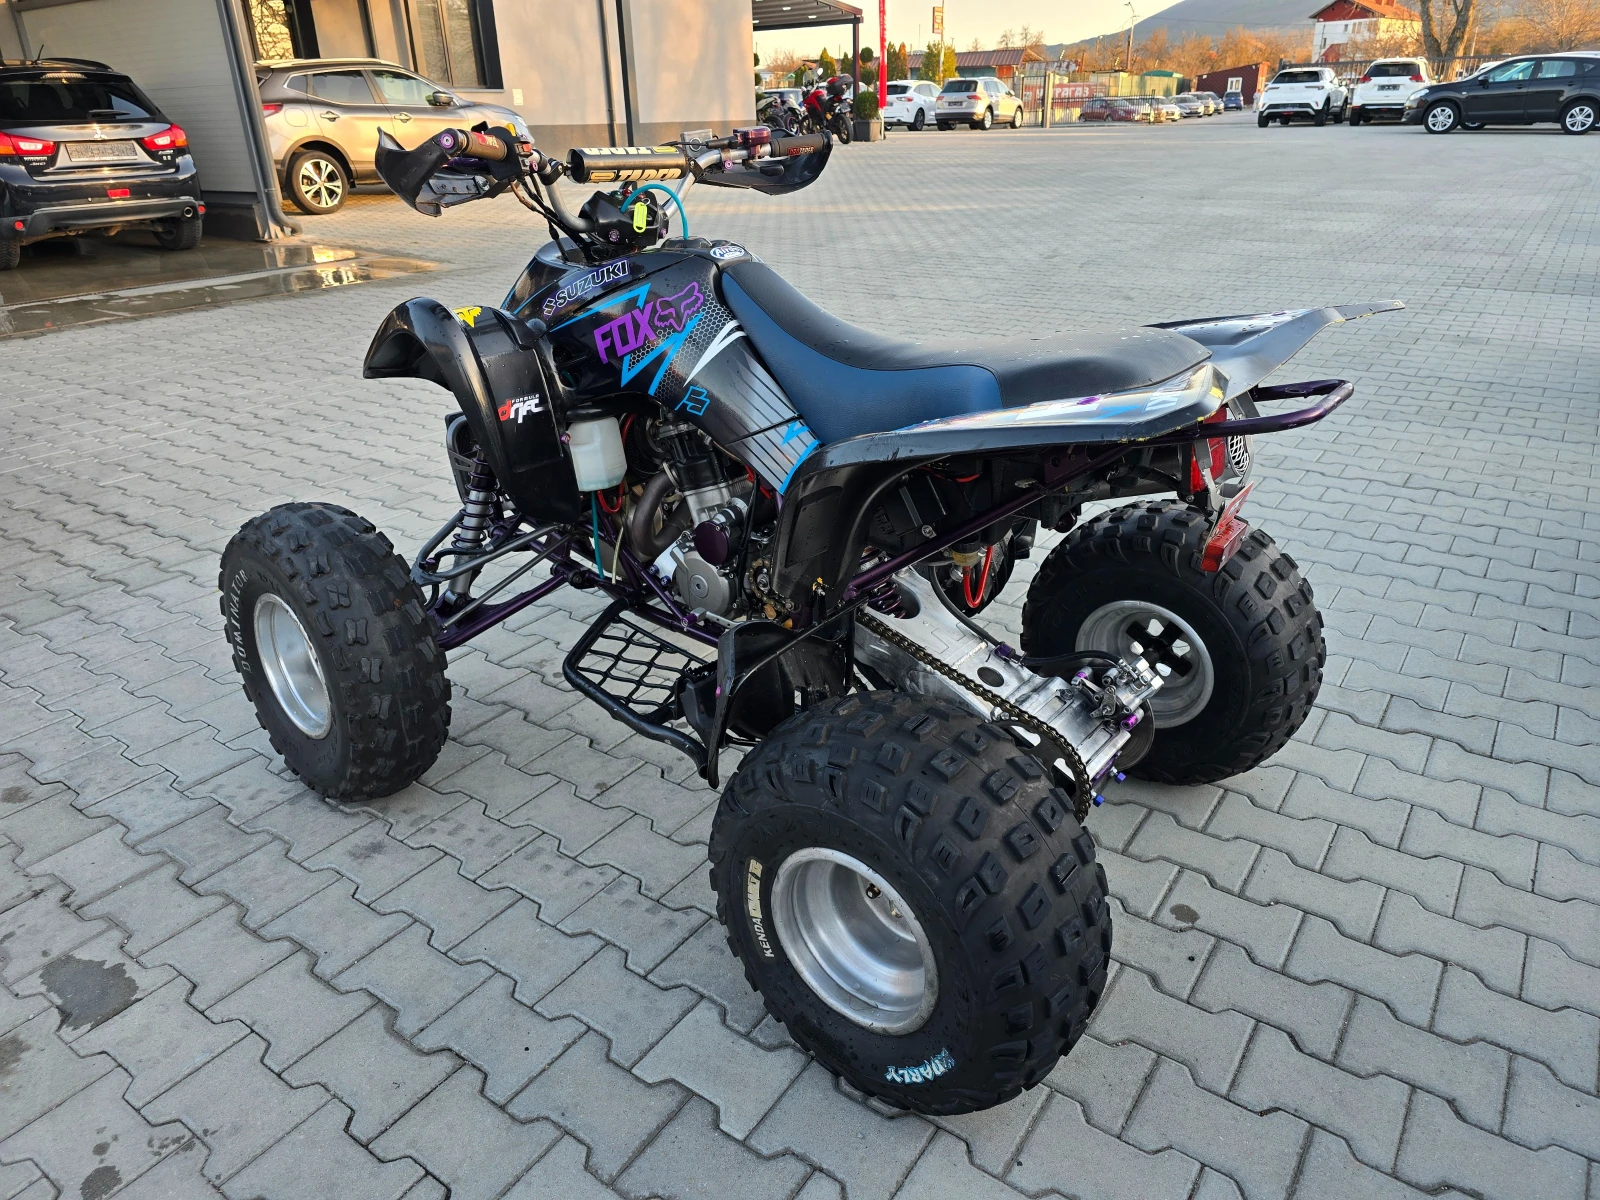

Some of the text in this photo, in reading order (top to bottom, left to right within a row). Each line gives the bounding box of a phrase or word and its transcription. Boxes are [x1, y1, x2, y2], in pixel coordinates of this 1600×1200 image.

[556, 260, 629, 307] SUZUKI
[593, 301, 657, 364] FOX
[230, 569, 252, 674] DOMINATOR
[752, 918, 775, 957] KENDA
